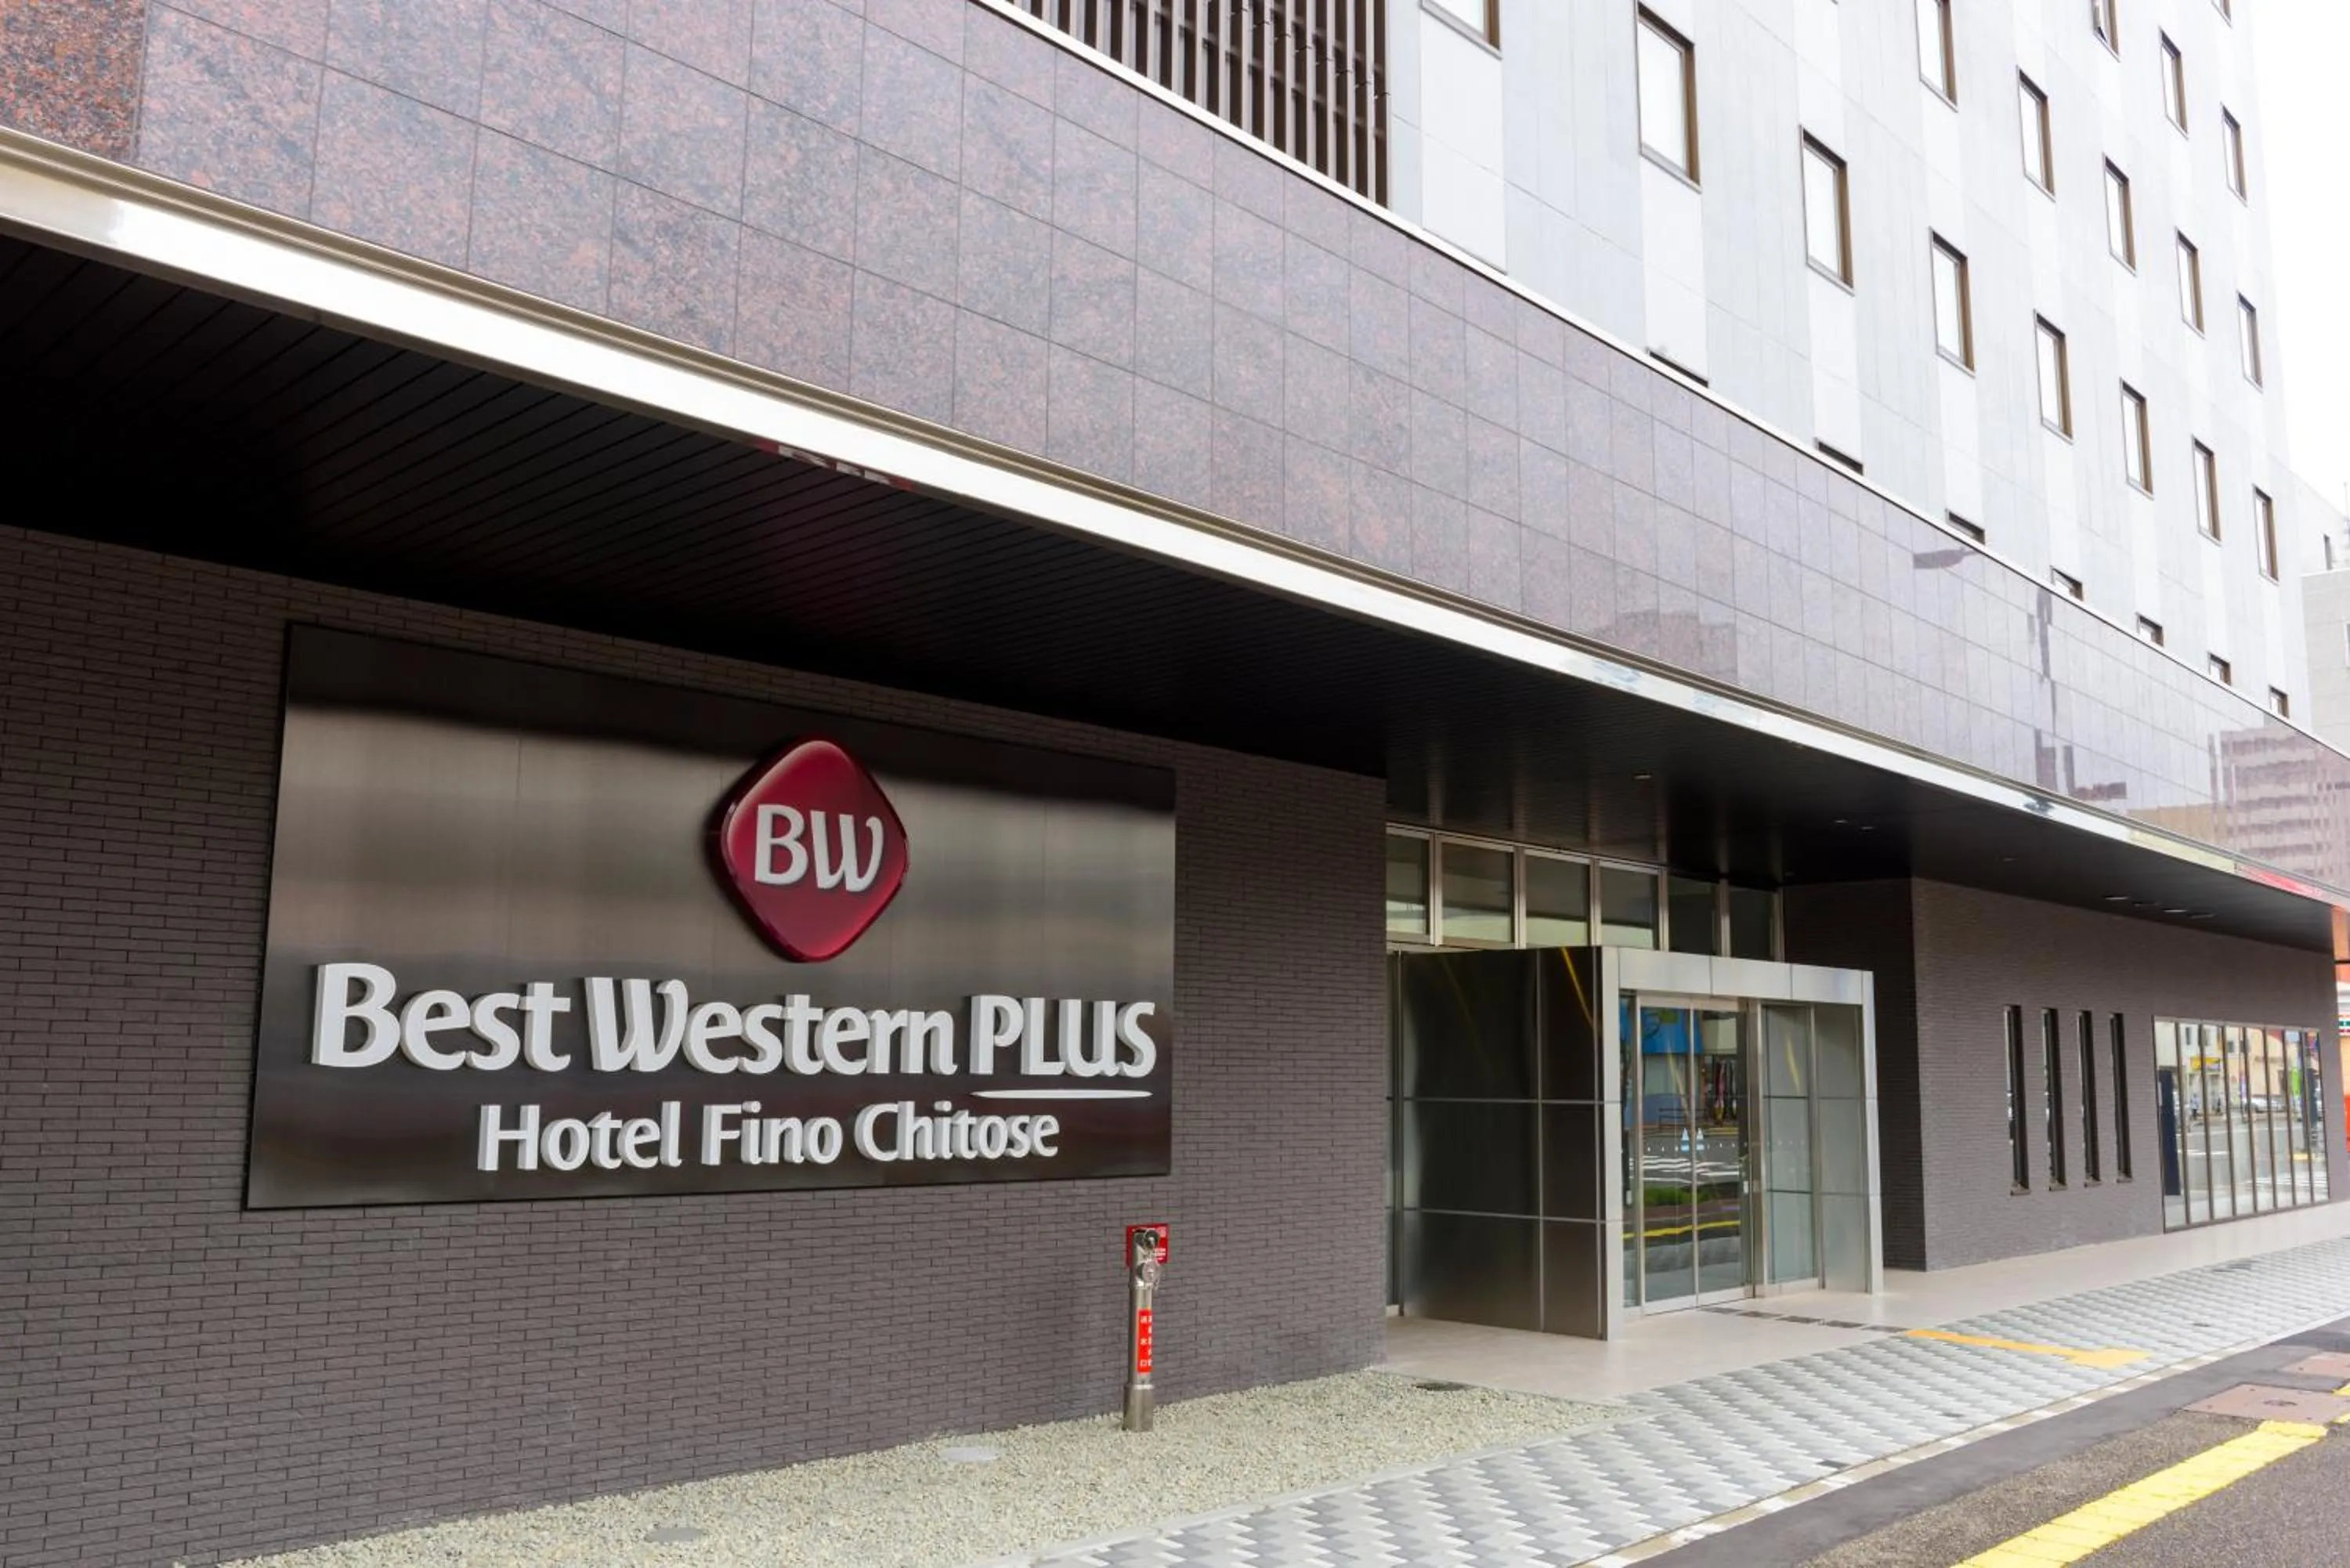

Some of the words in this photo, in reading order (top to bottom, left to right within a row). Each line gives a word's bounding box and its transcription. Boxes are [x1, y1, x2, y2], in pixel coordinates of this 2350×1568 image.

[754, 804, 884, 893] BW
[312, 963, 571, 1072] Best
[586, 977, 958, 1076] Western
[969, 995, 1157, 1078] PLUS
[477, 1100, 682, 1172] Hotel
[700, 1100, 844, 1166] Fino
[854, 1100, 1060, 1165] Chitose
